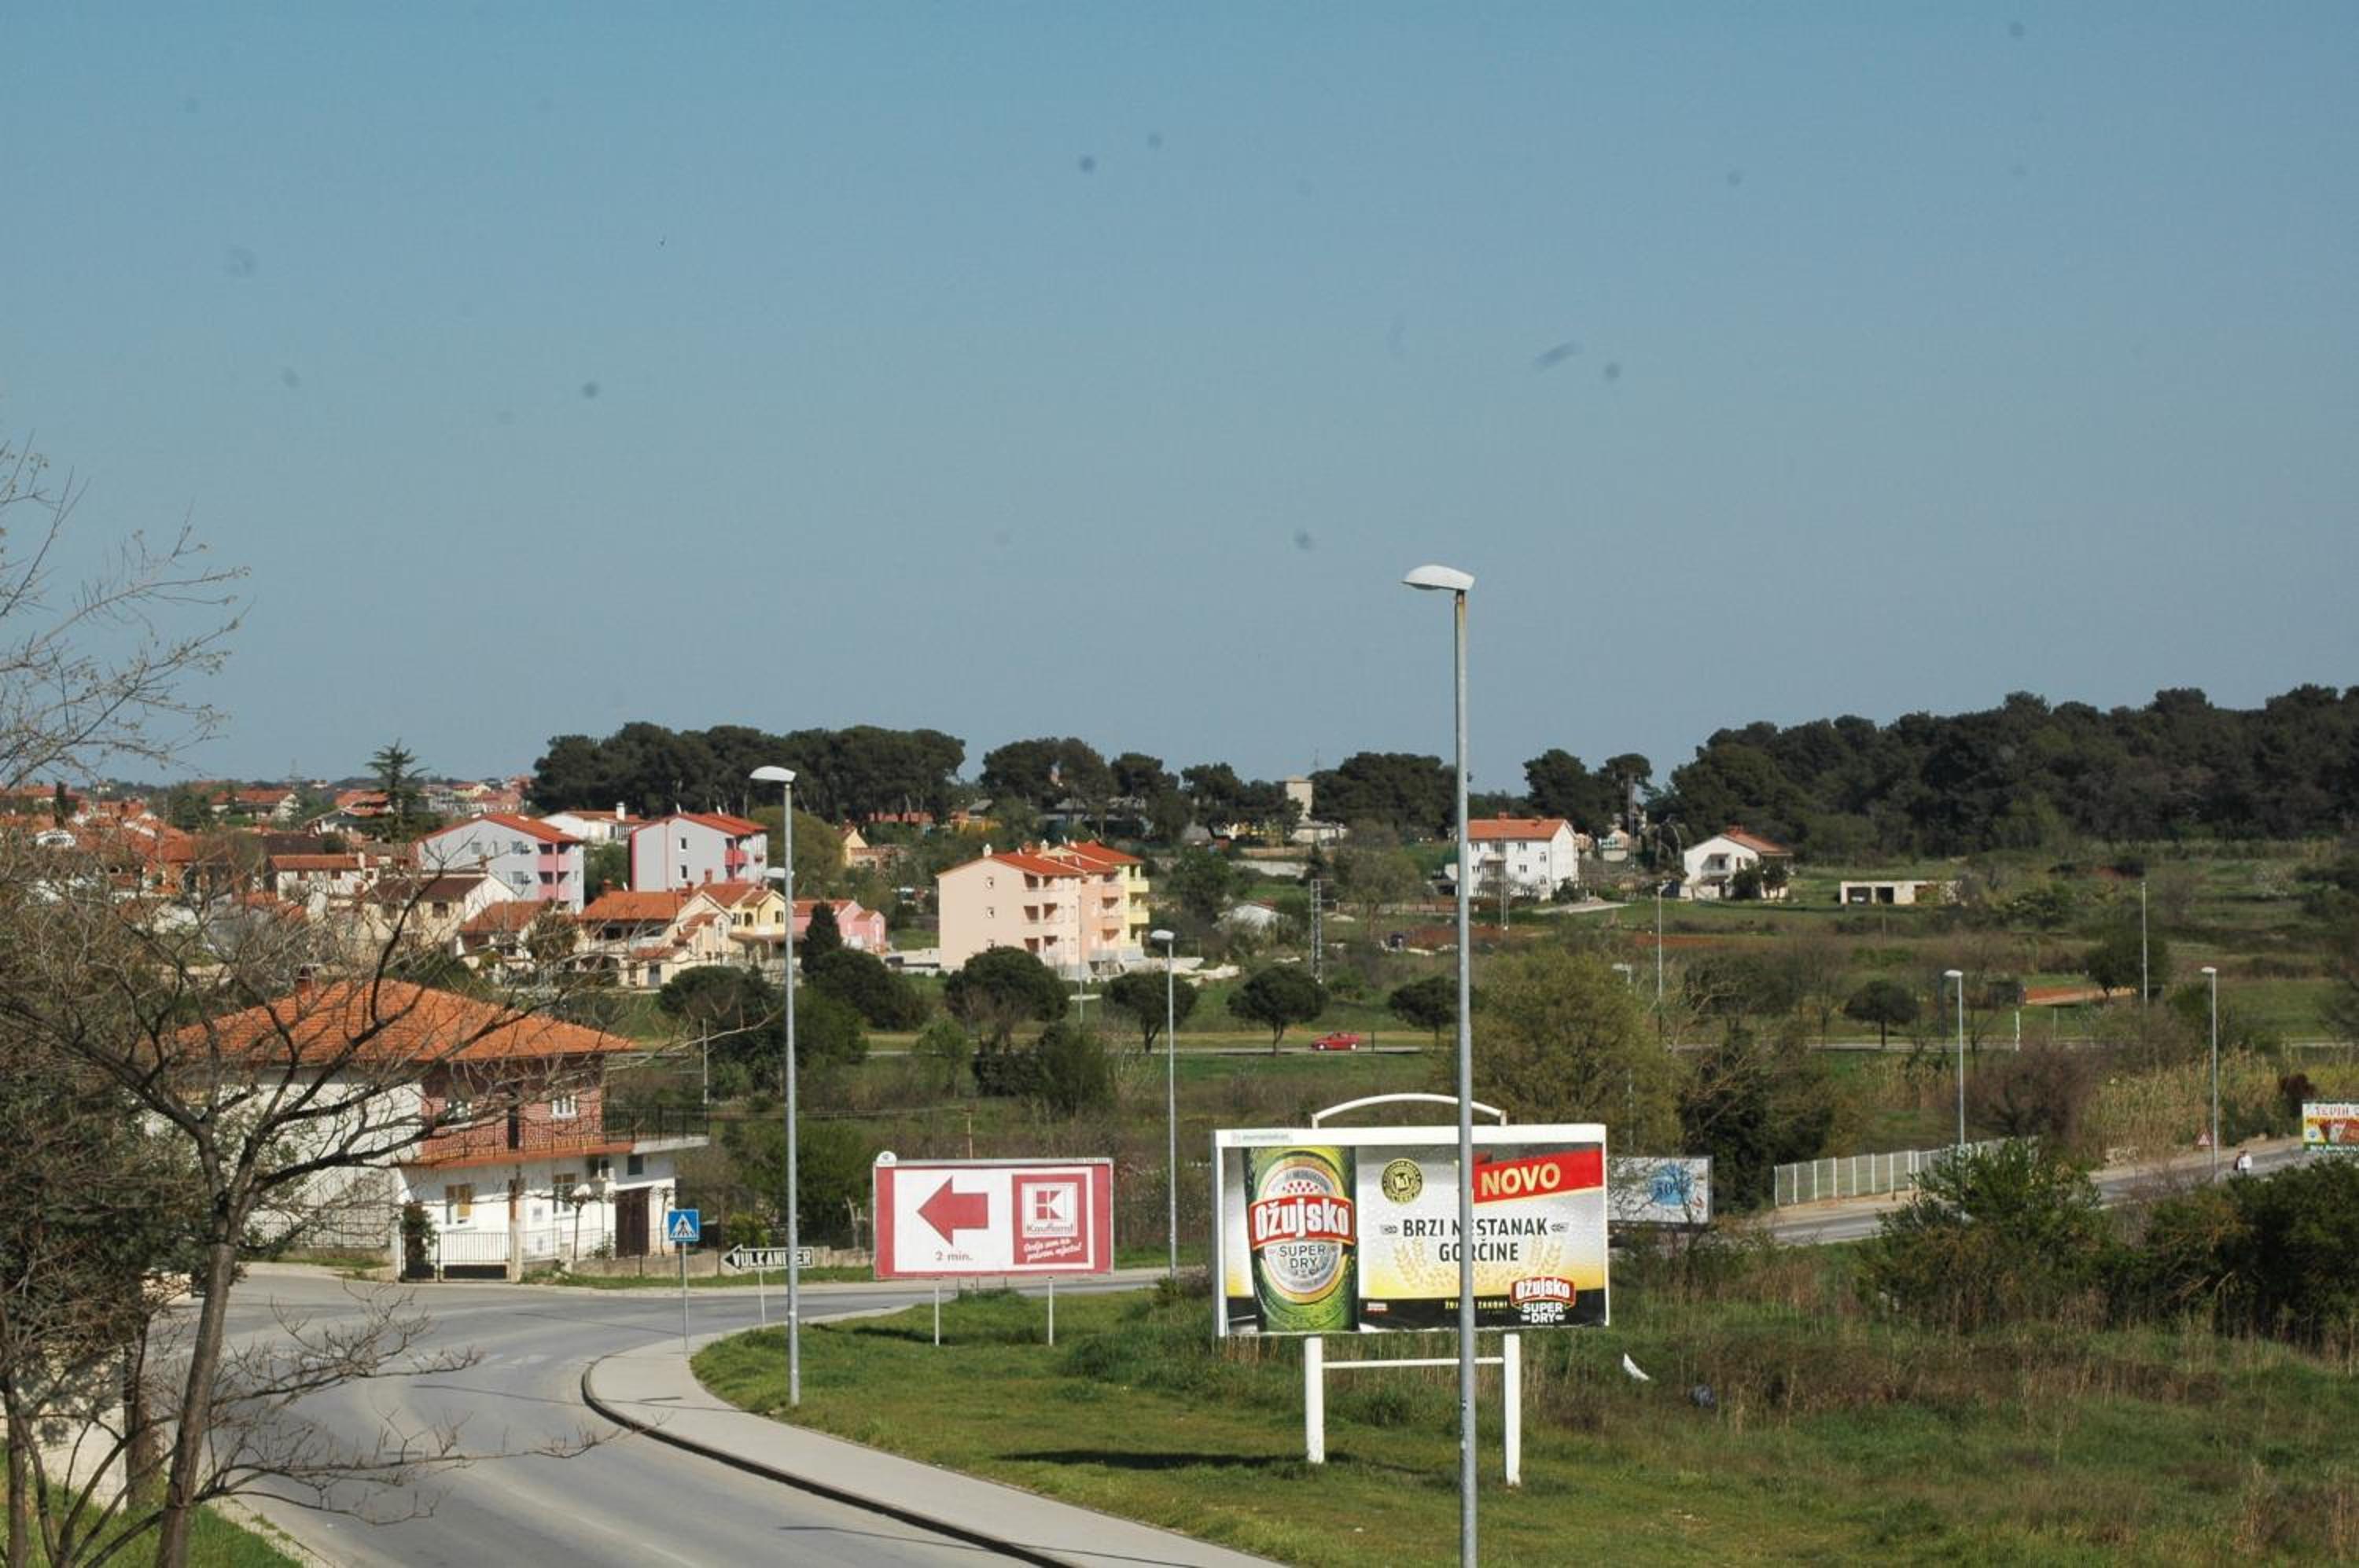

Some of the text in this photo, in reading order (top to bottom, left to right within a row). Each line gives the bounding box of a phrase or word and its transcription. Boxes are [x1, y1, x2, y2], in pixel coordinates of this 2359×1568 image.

[1481, 1163, 1561, 1197] NOVO
[1404, 1217, 1548, 1237] BRZI NSTANAK
[935, 1250, 944, 1261] 2
[1279, 1245, 1327, 1257] SUPER
[732, 1250, 811, 1266] VULKANIER
[1290, 1258, 1317, 1268] DRY
[1522, 1302, 1564, 1314] SUPER
[1531, 1313, 1556, 1323] DRY
